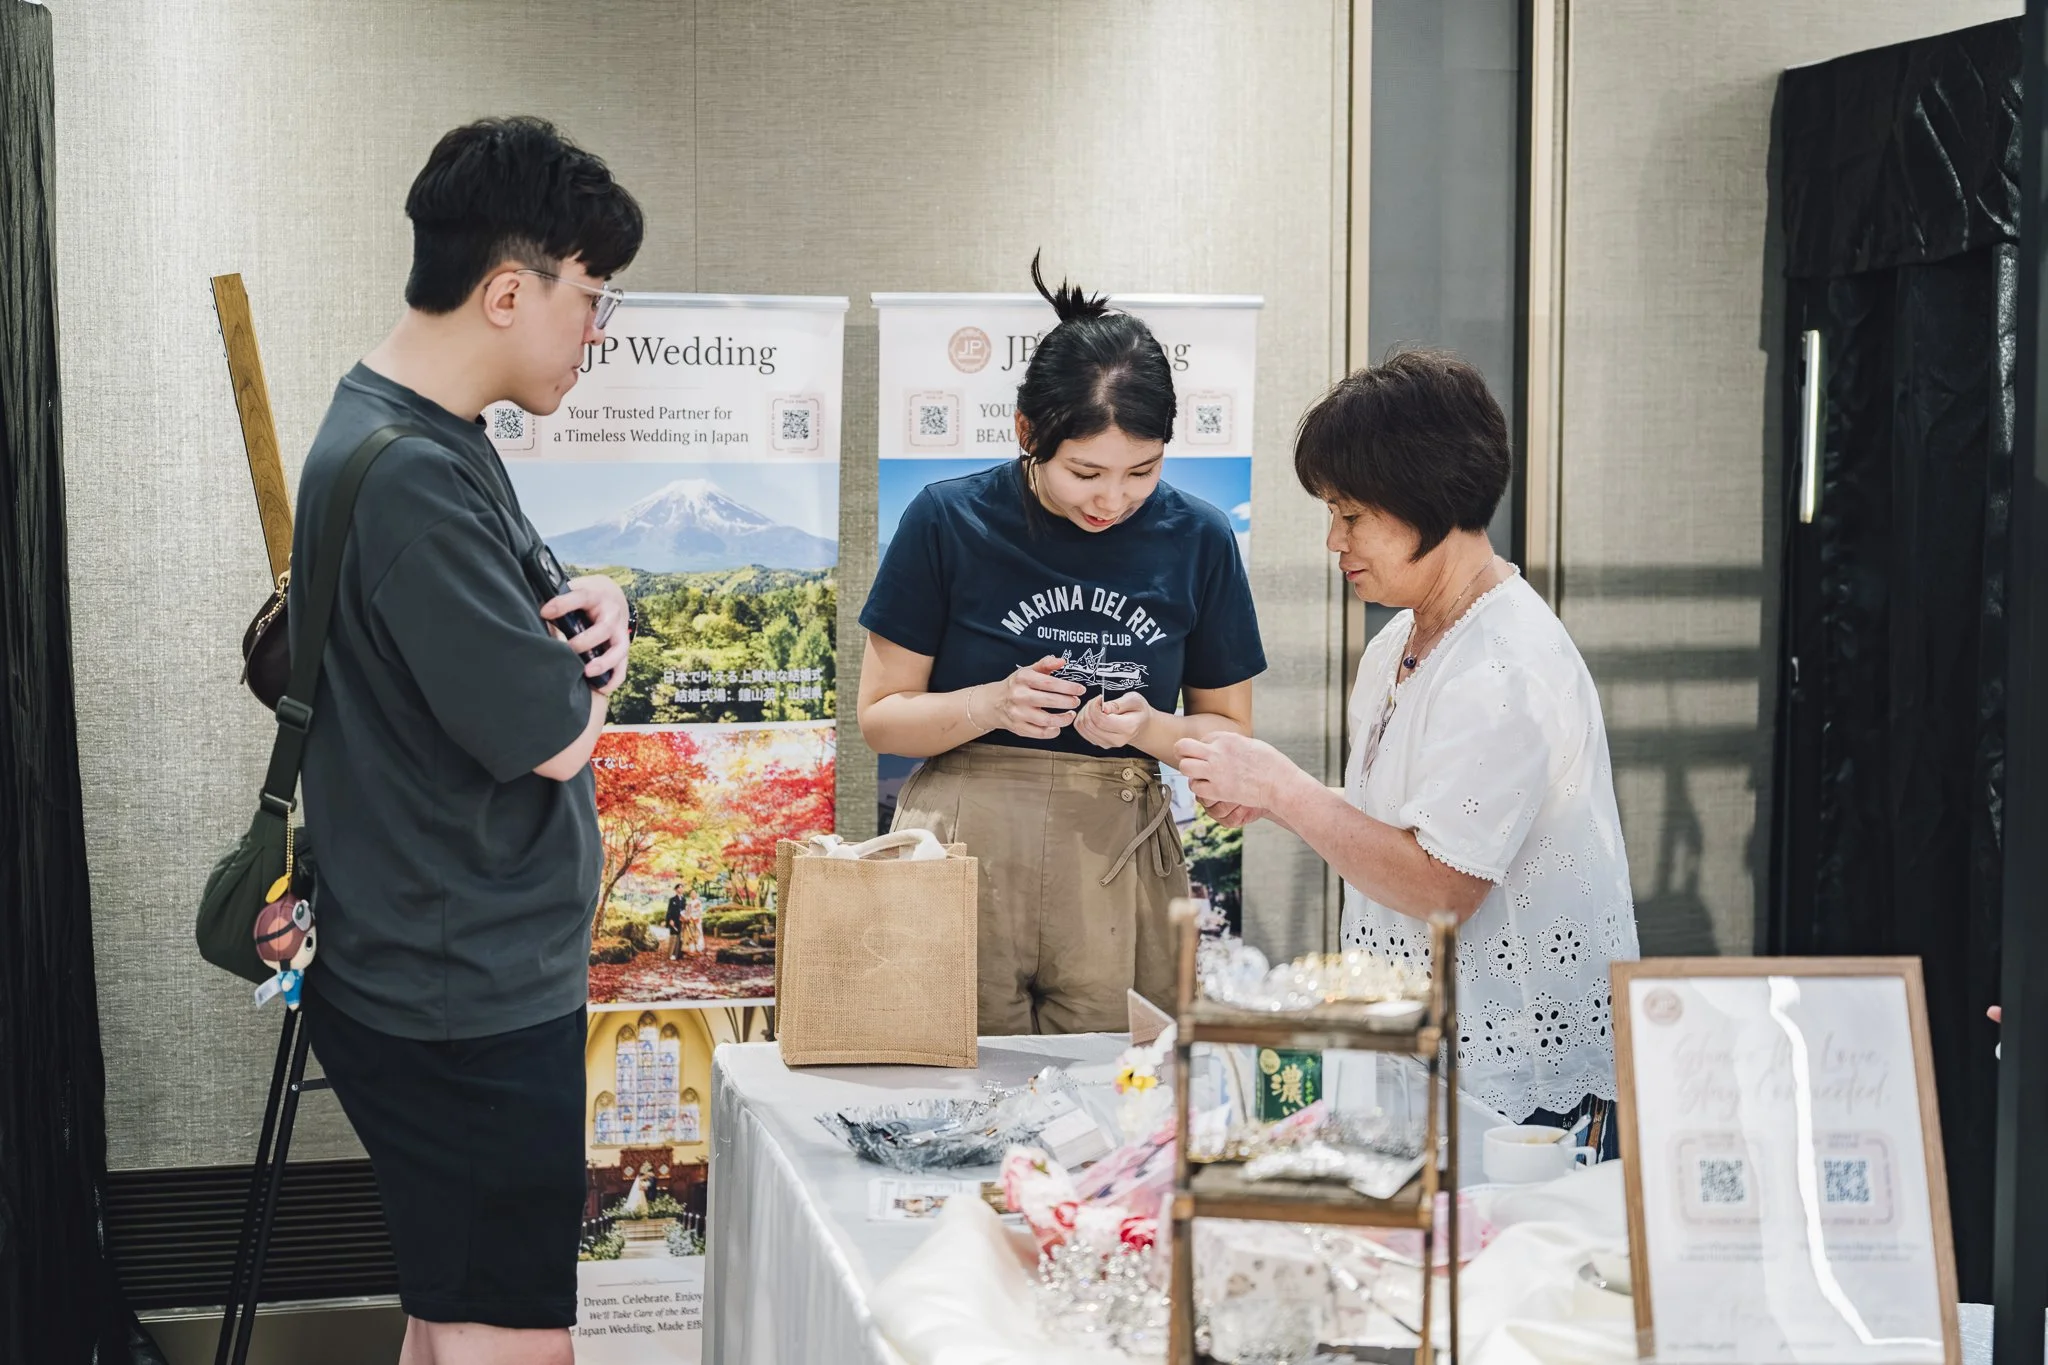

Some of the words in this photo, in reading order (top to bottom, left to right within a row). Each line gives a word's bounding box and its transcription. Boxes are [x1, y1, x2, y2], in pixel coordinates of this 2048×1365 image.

[957, 339, 982, 355] JP
[580, 336, 619, 373] JP
[626, 336, 778, 375] Wedding
[567, 406, 599, 420] Your
[602, 405, 655, 420] Trusted
[658, 406, 711, 421] Partner
[713, 405, 733, 421] for
[979, 403, 1017, 418] YOU
[553, 432, 561, 442] a
[565, 429, 626, 443] Timeless
[630, 429, 690, 445] Wedding
[694, 429, 708, 443] in
[711, 429, 749, 446] Japan
[976, 428, 1017, 443] BEAU
[1001, 584, 1084, 636] MARINA
[1090, 587, 1128, 622] DEL
[1125, 605, 1168, 647] REY
[1037, 626, 1099, 645] OUTRIGGER
[1102, 633, 1132, 647] CLUB
[583, 1296, 619, 1307] Dream.
[622, 1293, 672, 1305] Celebrate.
[612, 1310, 632, 1319] Take
[633, 1309, 653, 1319] Care
[655, 1308, 665, 1318] of
[665, 1308, 679, 1317] the
[578, 1326, 607, 1337] Japan
[658, 1321, 685, 1332] Made
